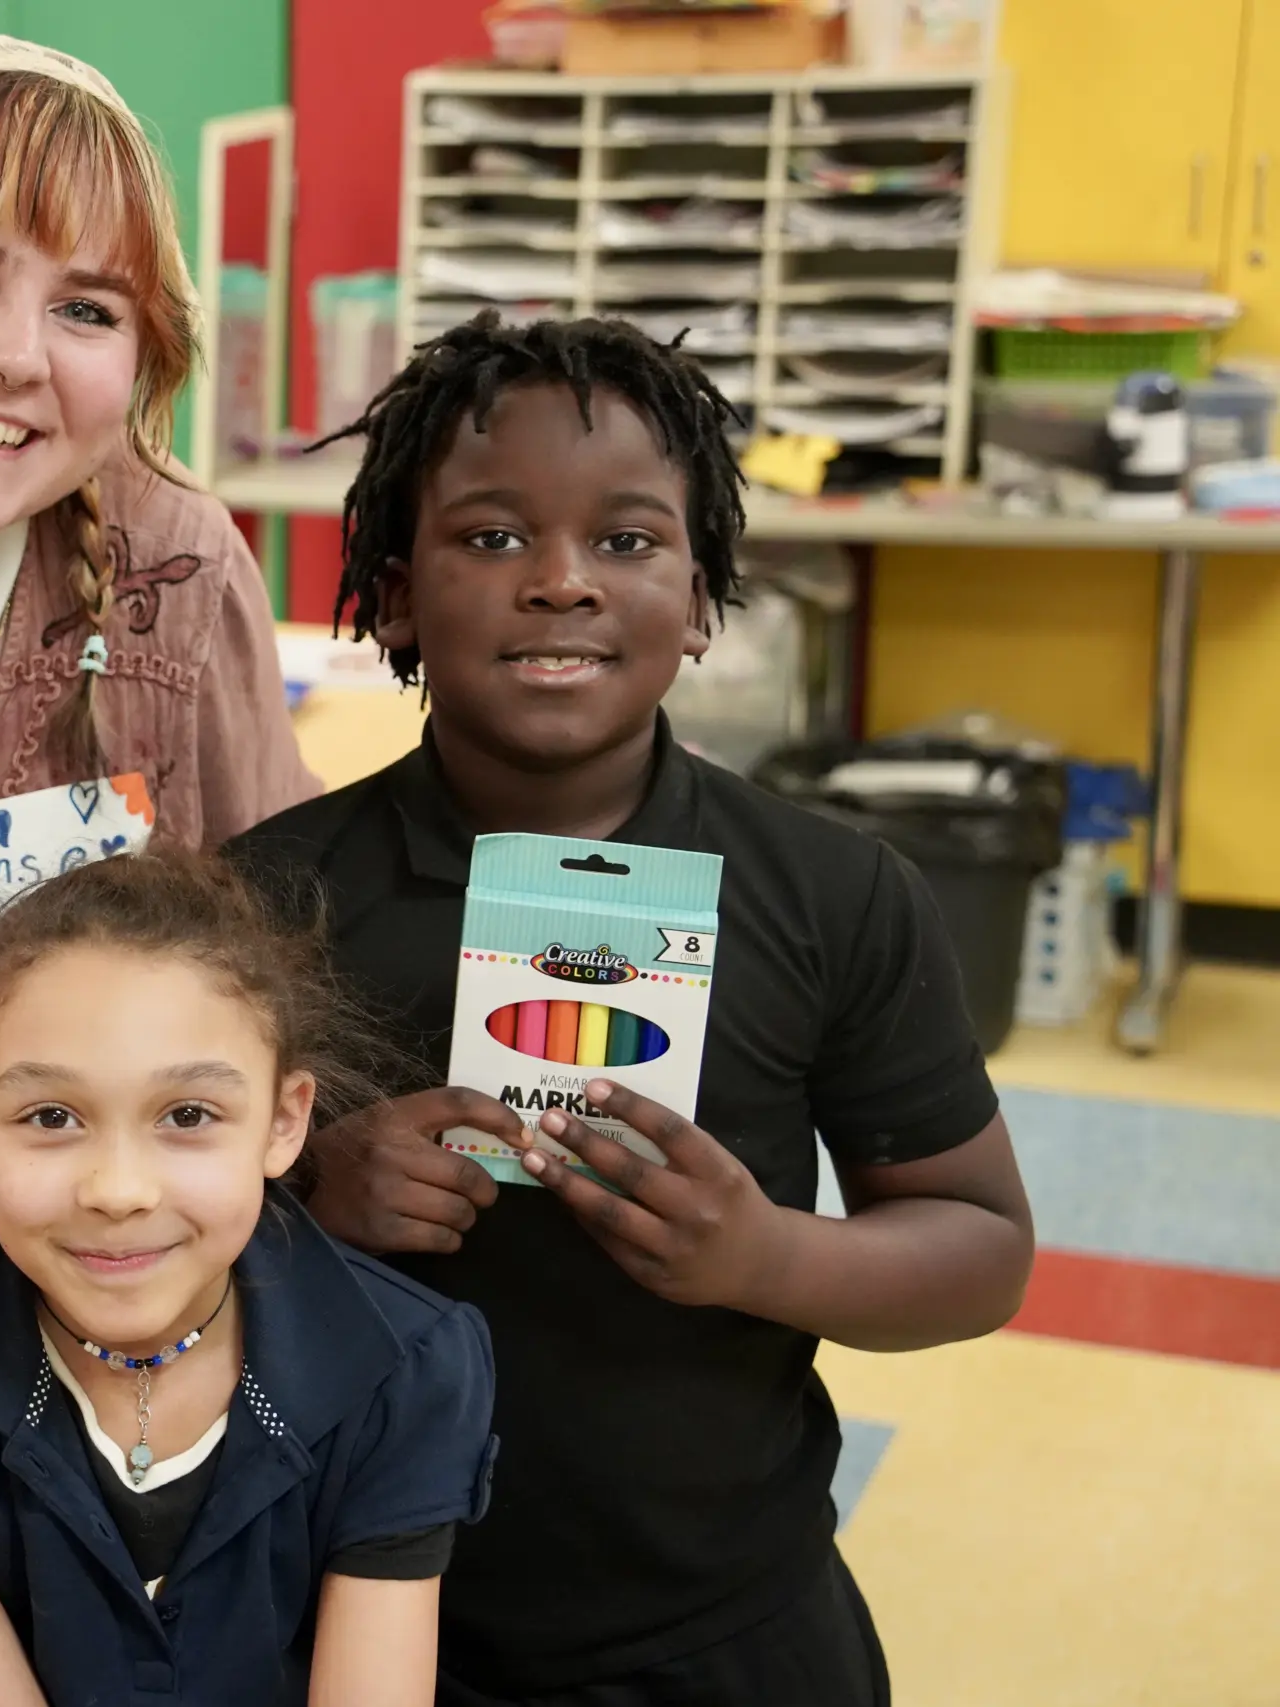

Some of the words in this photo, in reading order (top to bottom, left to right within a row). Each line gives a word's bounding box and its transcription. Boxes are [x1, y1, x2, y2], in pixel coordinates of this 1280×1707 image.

[684, 936, 701, 953] 8
[545, 944, 625, 969] Creative
[680, 952, 705, 963] COUNT
[548, 964, 619, 981] COLORS
[540, 1073, 588, 1091] WASHAB
[598, 1128, 625, 1144] TOXIC
